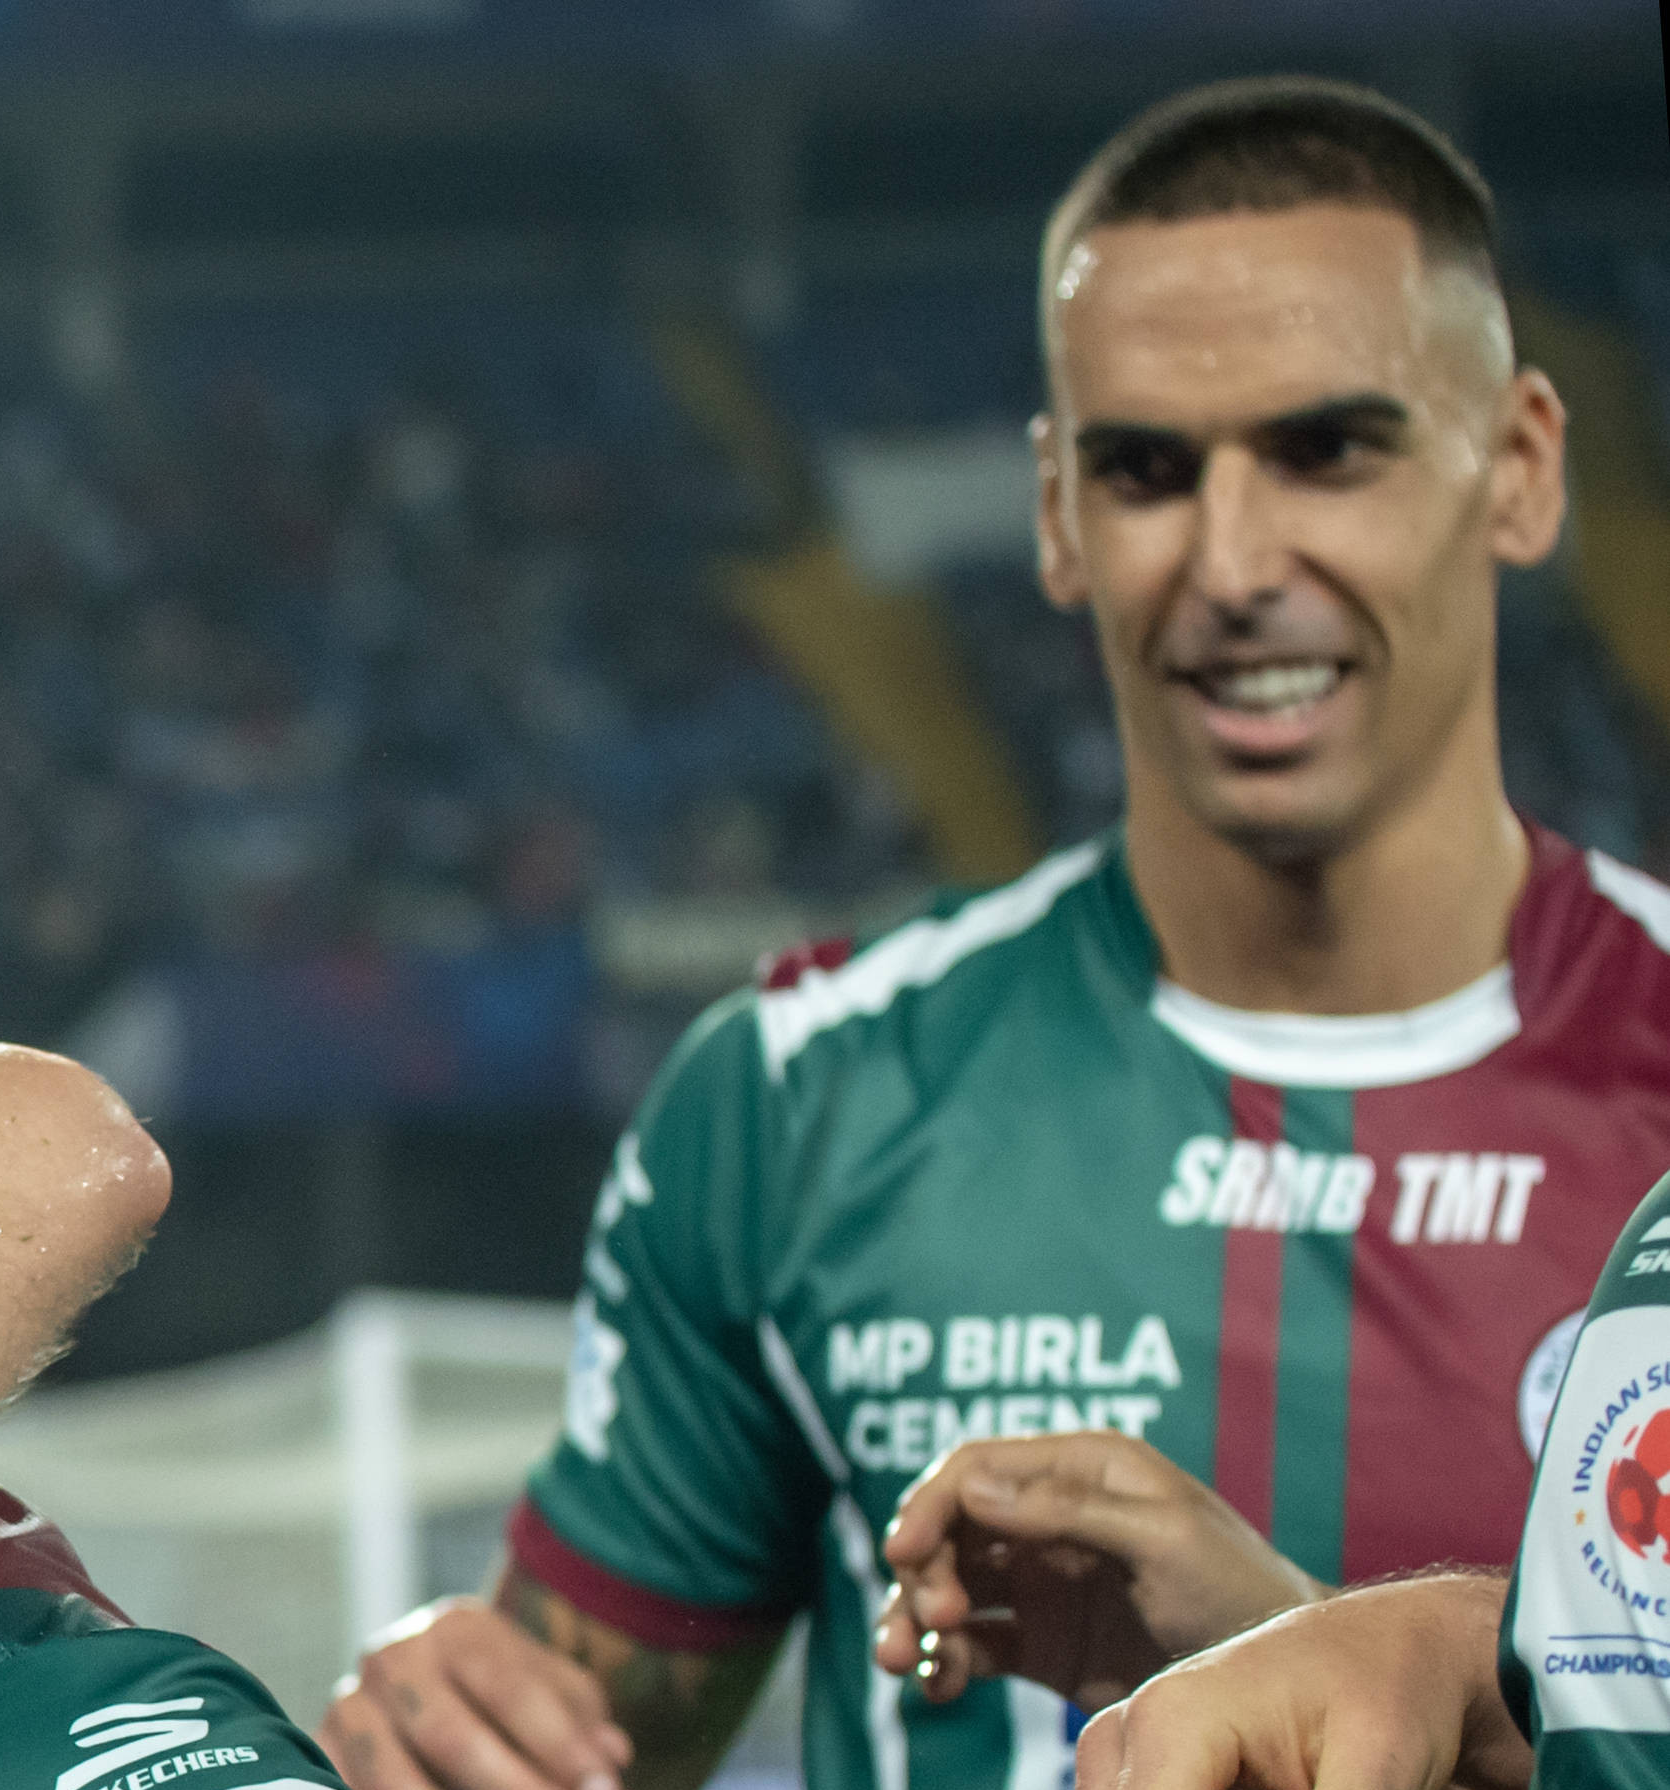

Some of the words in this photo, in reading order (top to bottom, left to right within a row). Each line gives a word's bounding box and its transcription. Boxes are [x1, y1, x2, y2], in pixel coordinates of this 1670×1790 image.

[1161, 1135, 1376, 1233] SRMB
[1389, 1151, 1547, 1245] TMT
[827, 1317, 934, 1393] MP
[942, 1313, 1183, 1390] BIRLA
[1572, 1379, 1641, 1492] INDIAN
